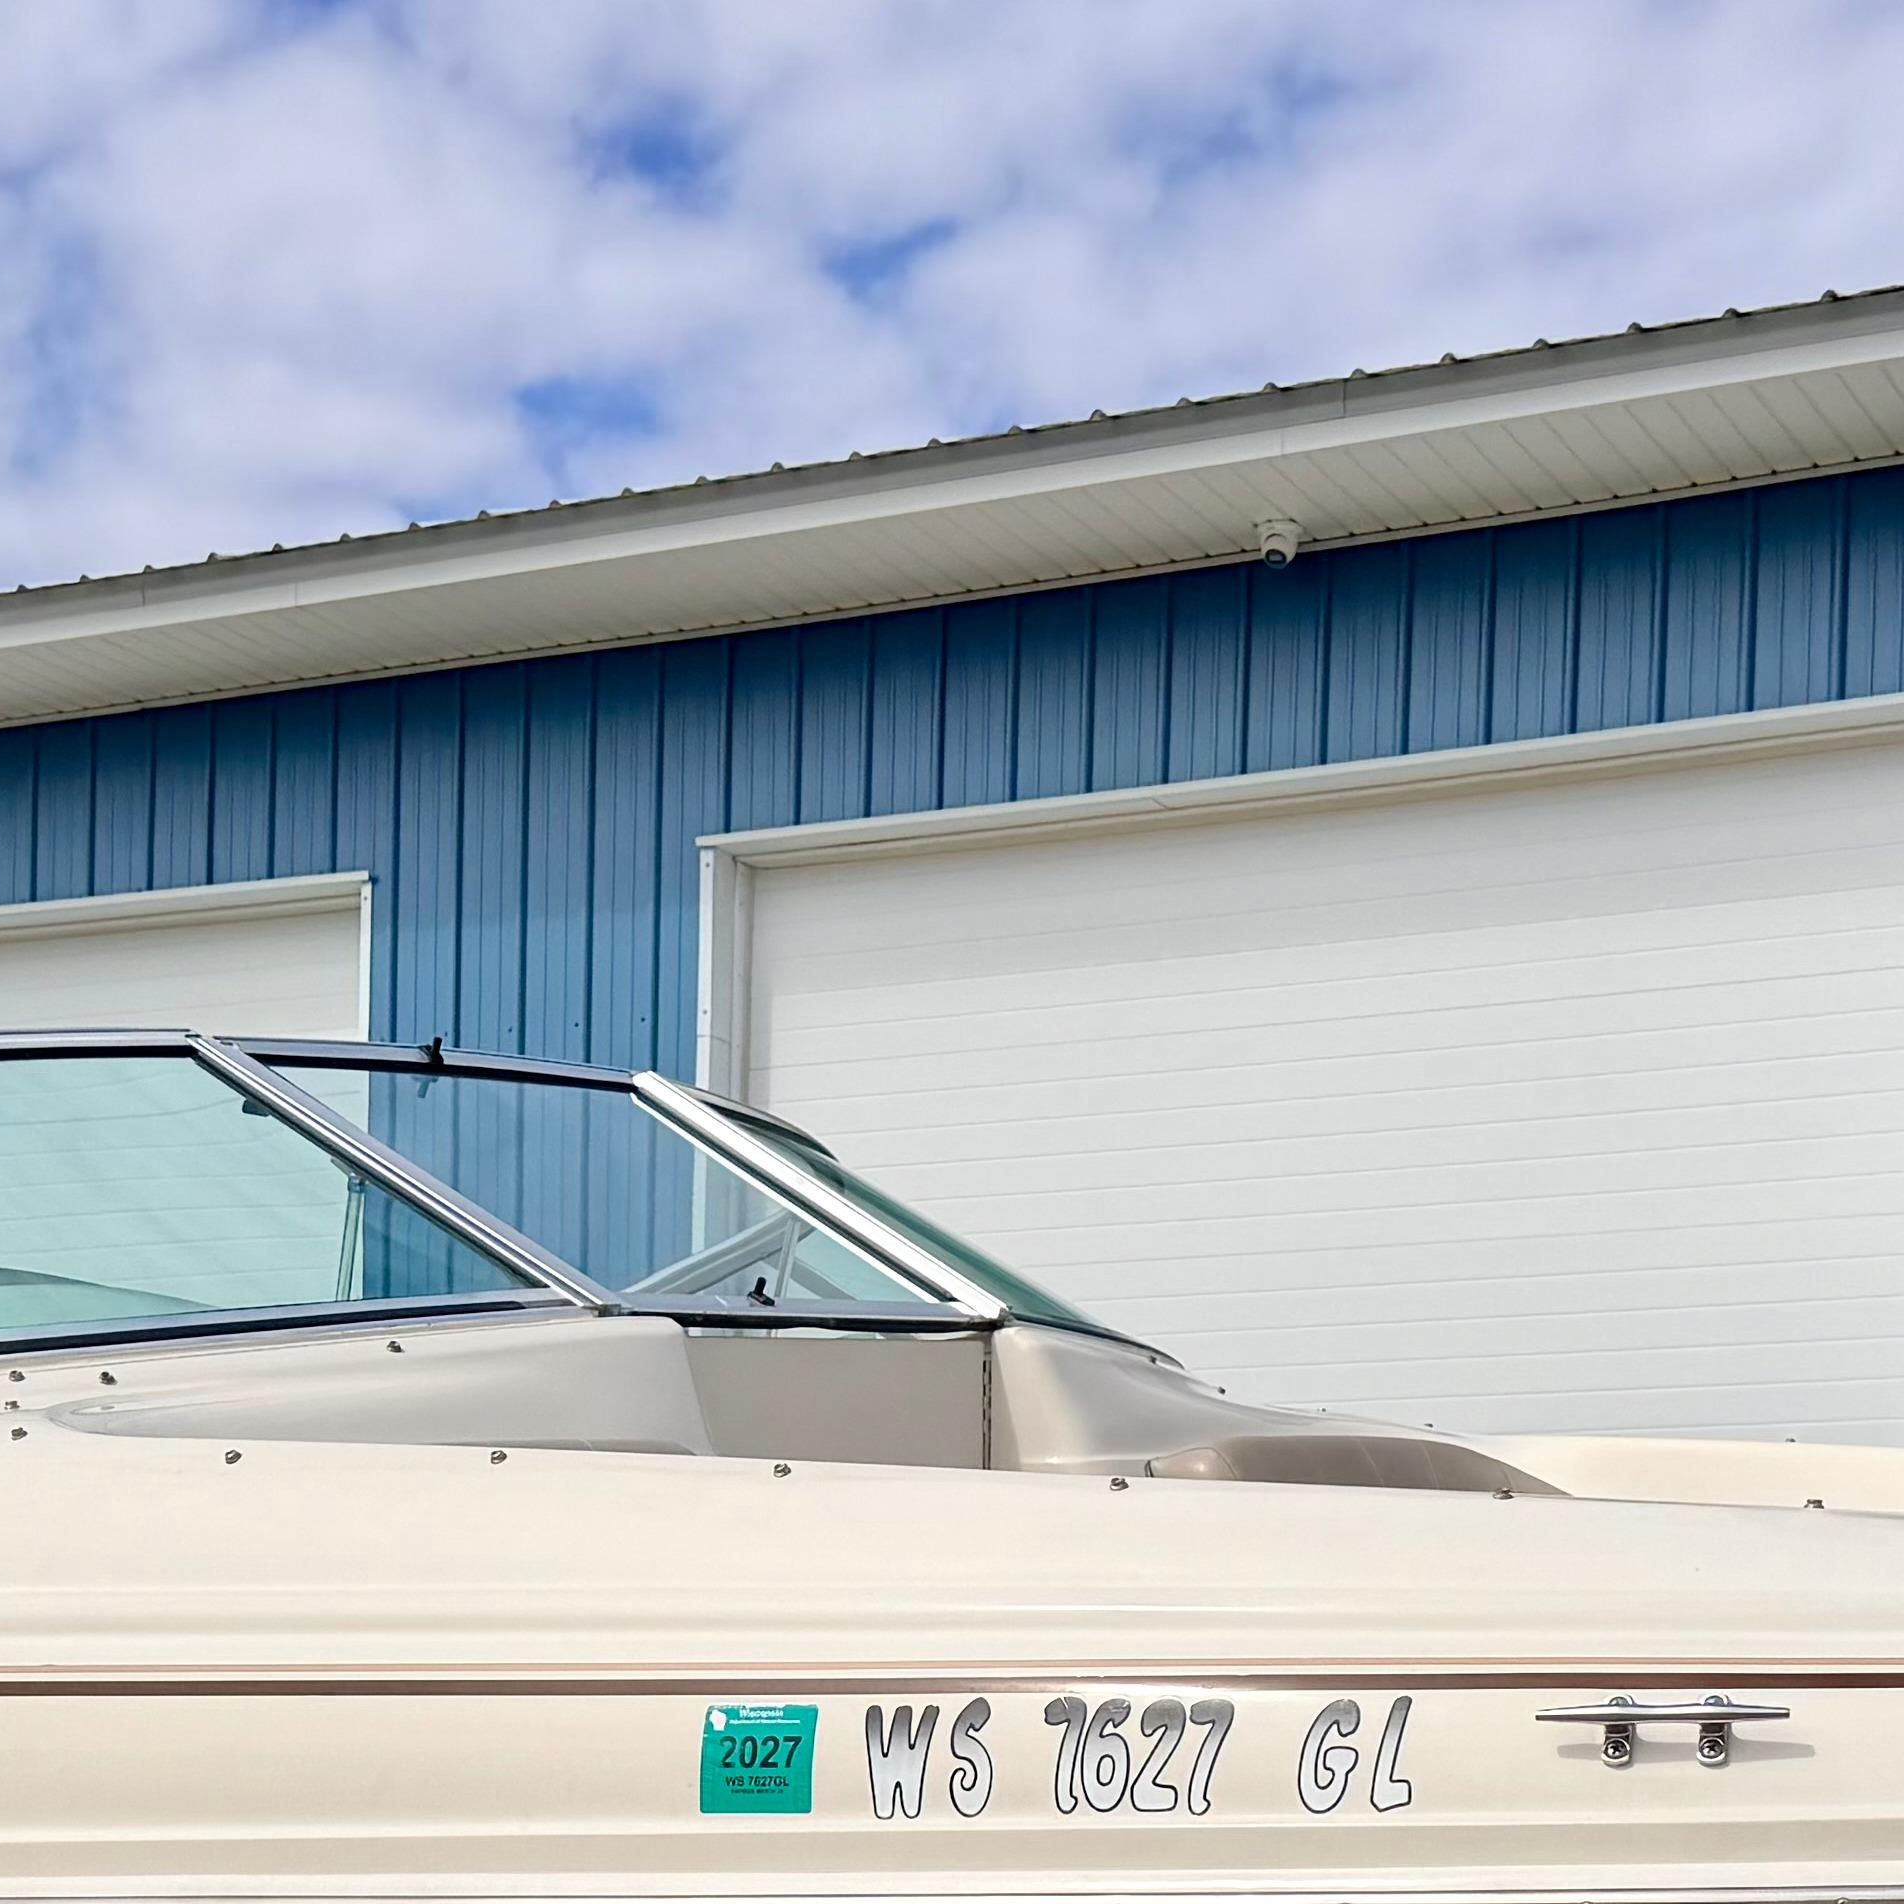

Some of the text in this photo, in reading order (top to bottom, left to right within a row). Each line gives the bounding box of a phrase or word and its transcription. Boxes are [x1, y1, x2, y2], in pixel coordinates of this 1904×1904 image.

[719, 1735, 803, 1769] 2027
[865, 1696, 1412, 1819] WS 7627 GL
[725, 1776, 745, 1787] WS
